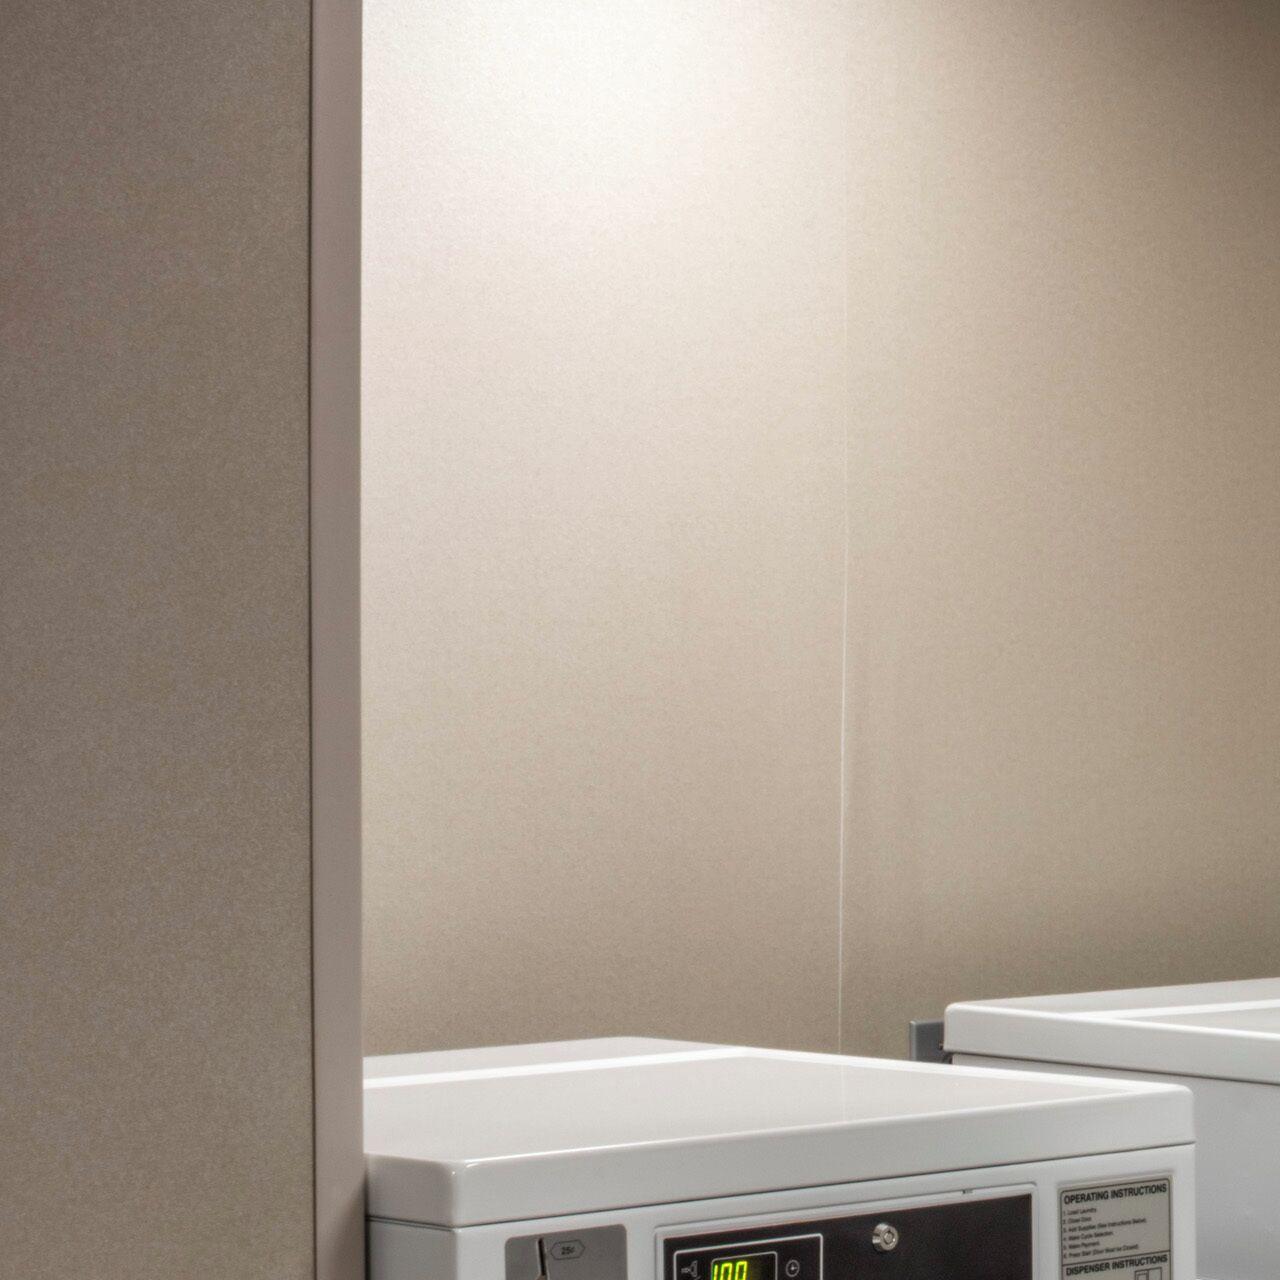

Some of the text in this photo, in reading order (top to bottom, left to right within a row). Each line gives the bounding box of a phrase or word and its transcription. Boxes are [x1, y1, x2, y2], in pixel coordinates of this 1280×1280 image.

[1064, 1184, 1167, 1205] OPERATING INSTRUCTIONS
[1066, 1254, 1168, 1276] DISPENSER INSTRUCTIONS
